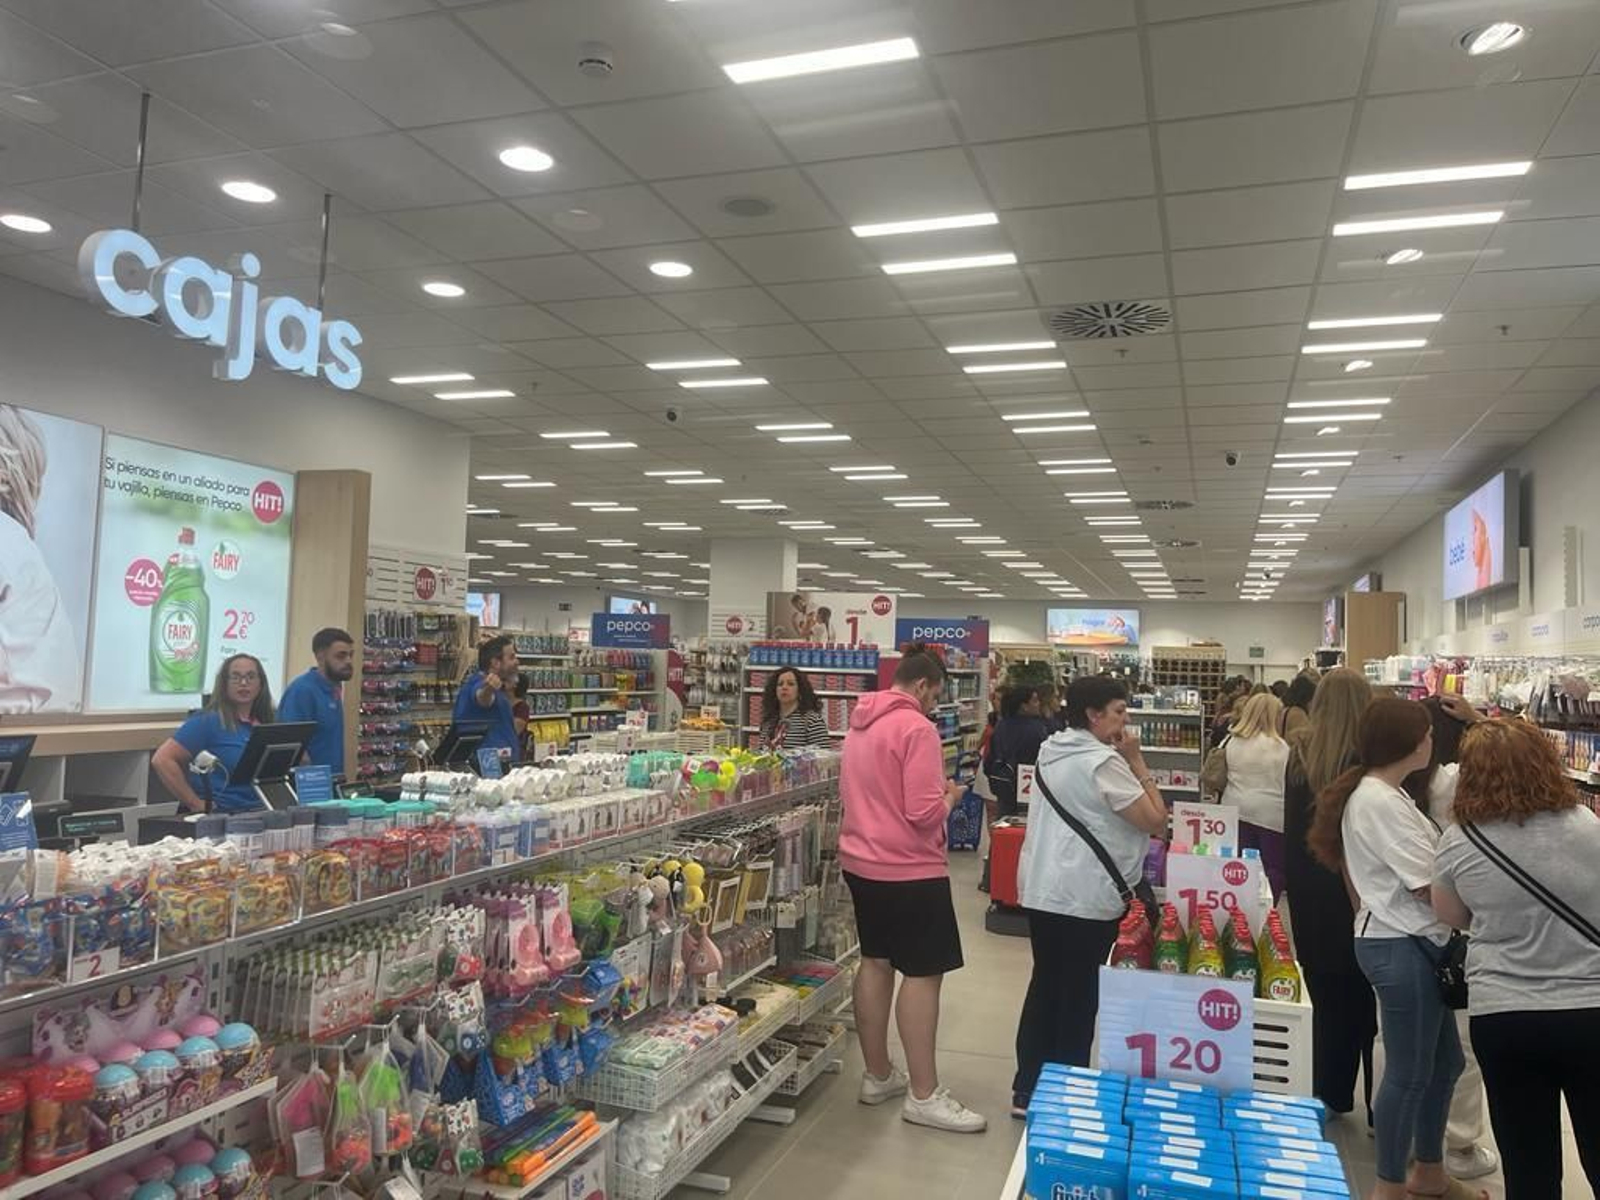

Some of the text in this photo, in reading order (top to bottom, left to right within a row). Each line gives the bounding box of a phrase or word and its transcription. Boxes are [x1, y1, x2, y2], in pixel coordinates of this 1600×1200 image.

[80, 229, 363, 390] cajas
[105, 457, 250, 498] Si piensas en un aliado para
[103, 477, 116, 490] tu
[153, 486, 194, 504] piensas
[196, 495, 210, 506] en
[211, 496, 242, 512] Pepco
[254, 492, 282, 513] HIT!
[213, 552, 240, 572] FAIRY
[167, 624, 192, 641] FAIRY
[223, 609, 239, 640] 2
[606, 620, 651, 633] pepco
[846, 617, 859, 645] 1
[912, 626, 966, 641] pepco
[1180, 809, 1206, 818] desde
[1186, 819, 1226, 845] 1 30
[1224, 867, 1247, 880] HIT!
[1178, 888, 1238, 930] 1 50
[88, 954, 102, 977] 2
[1272, 985, 1292, 997] FAIRY
[1201, 1000, 1238, 1020] HIT!
[1125, 1033, 1222, 1079] 1 20
